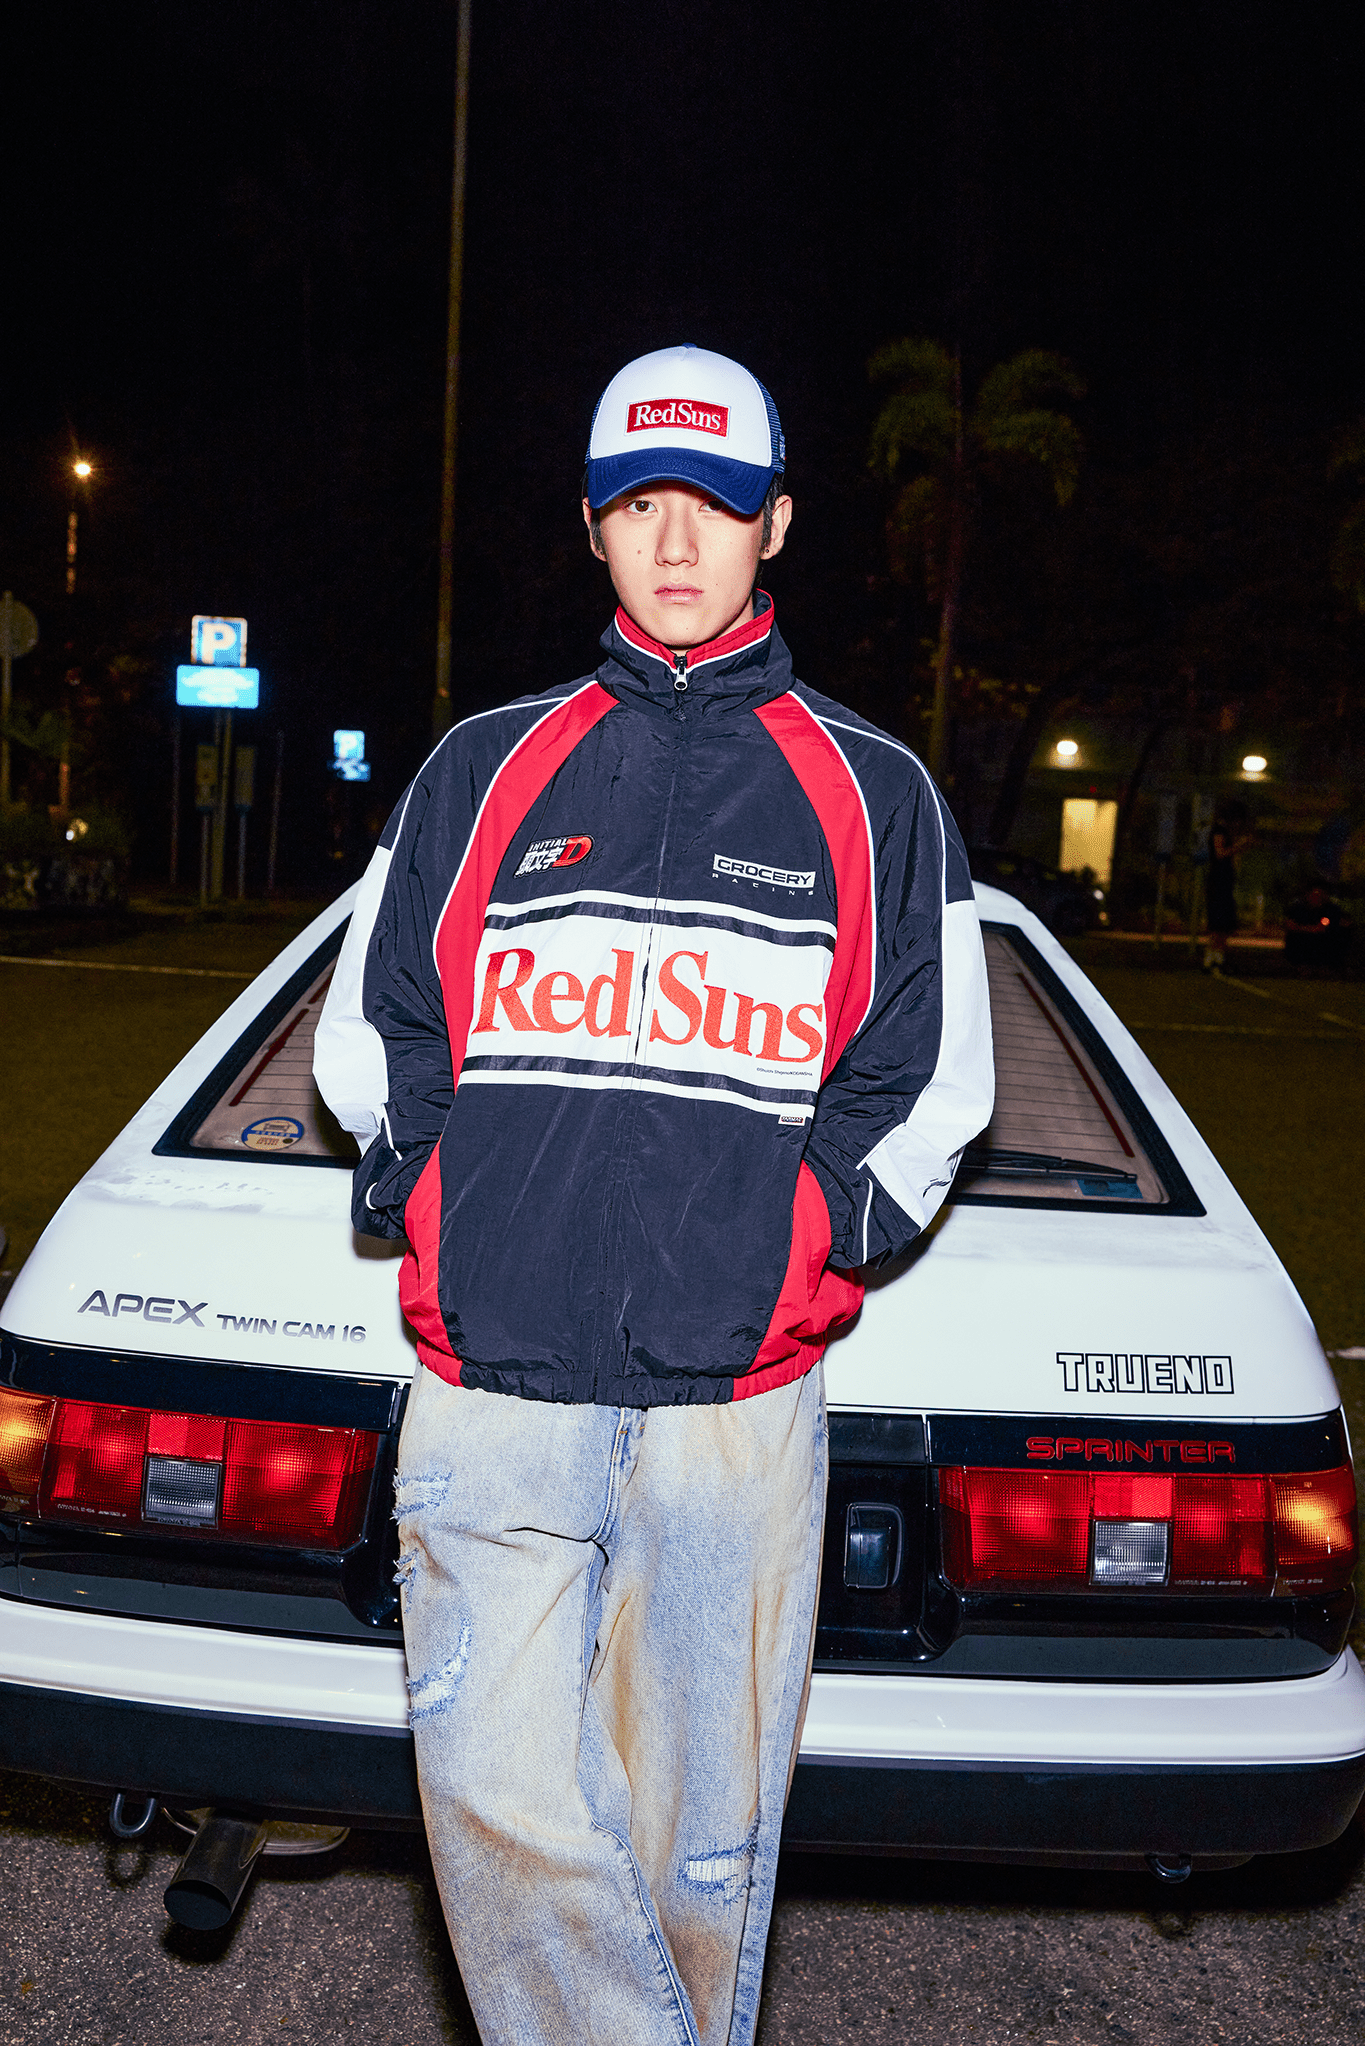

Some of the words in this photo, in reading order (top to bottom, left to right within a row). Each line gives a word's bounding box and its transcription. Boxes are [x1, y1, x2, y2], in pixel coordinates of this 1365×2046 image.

[201, 622, 237, 664] P
[528, 838, 567, 851] INITIAL
[552, 836, 592, 867] D
[712, 872, 814, 896] RACING
[717, 858, 812, 885] GROCERY
[471, 948, 634, 1037] Red
[649, 950, 824, 1063] Suns
[77, 1289, 209, 1327] APEX
[216, 1313, 277, 1335] TWIN
[283, 1321, 335, 1341] CAM
[342, 1324, 367, 1344] 16
[1056, 1352, 1235, 1395] TRUENO
[1026, 1436, 1236, 1463] SPRINTER
